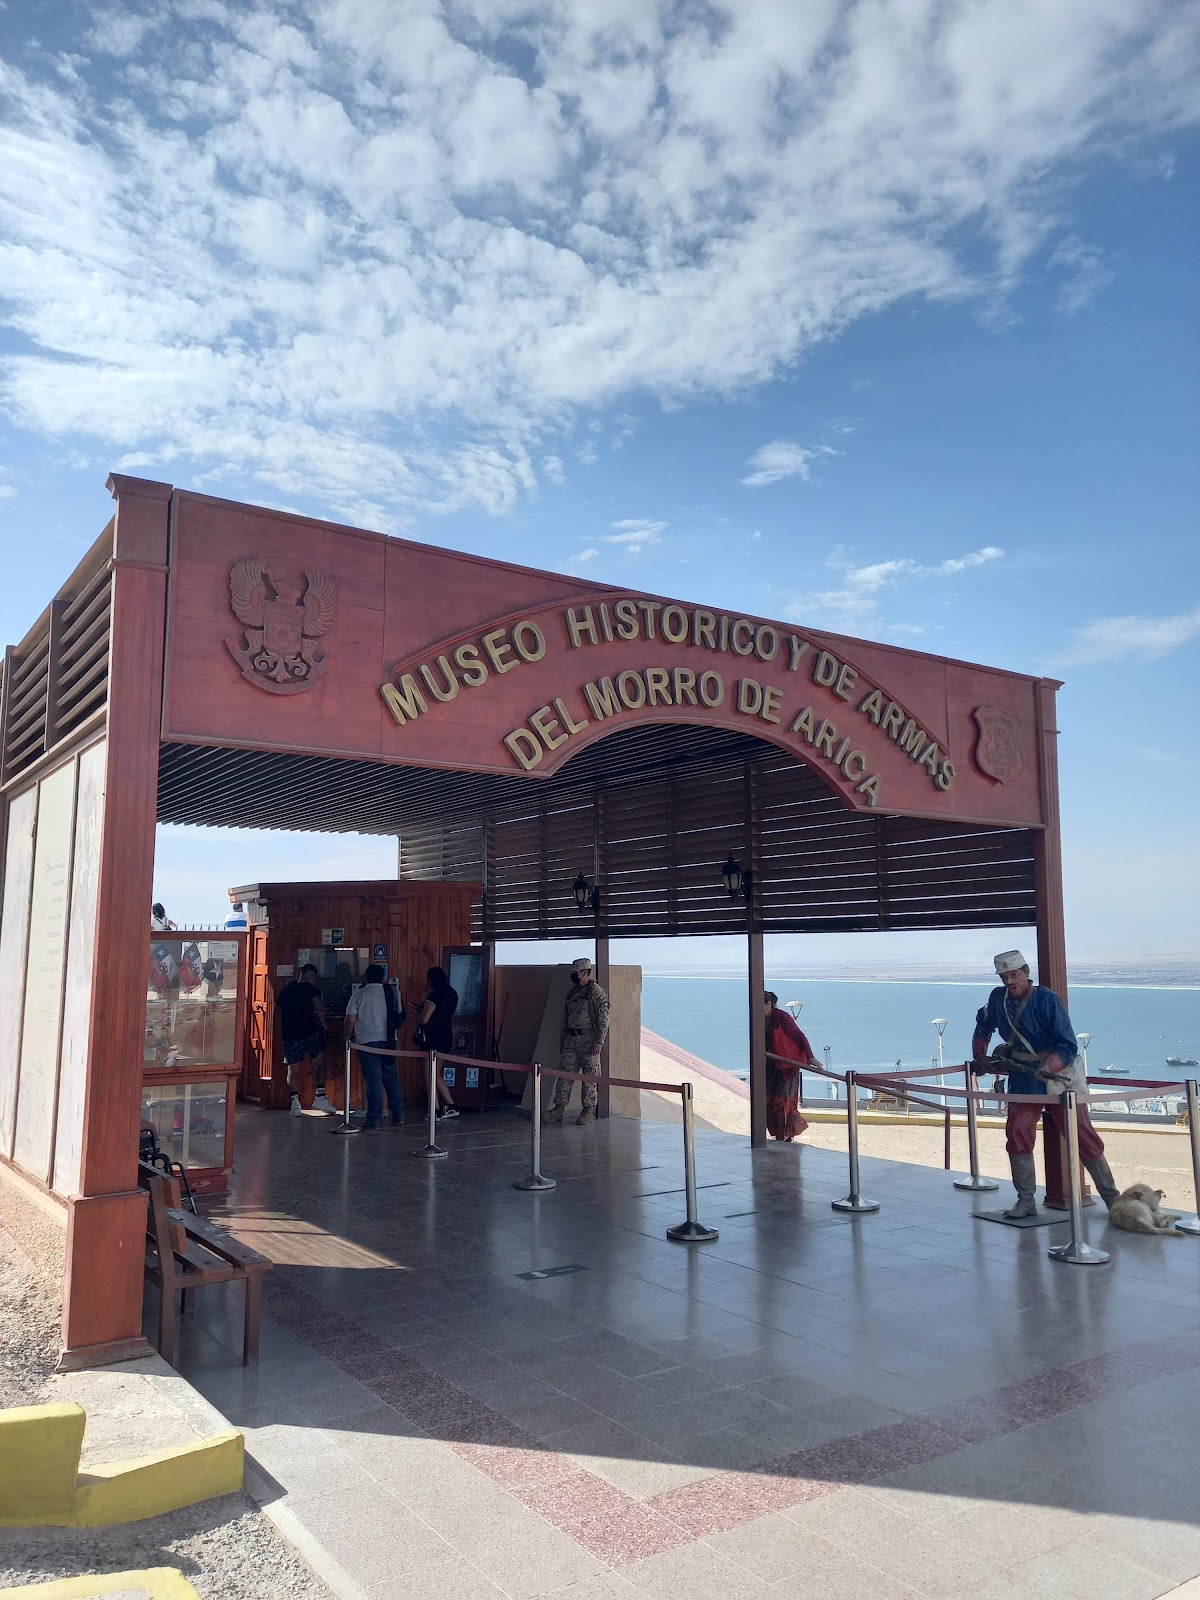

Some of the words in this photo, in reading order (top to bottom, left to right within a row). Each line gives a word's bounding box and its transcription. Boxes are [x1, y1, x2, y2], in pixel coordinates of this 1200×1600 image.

[379, 620, 547, 726] MUSEO
[565, 600, 779, 662] HISTORICO
[788, 634, 811, 672] Y
[813, 650, 859, 702] DE
[859, 689, 956, 792] ARMAS
[503, 697, 589, 771] DEL
[583, 667, 724, 721] MORRO
[737, 677, 784, 724] DE
[791, 706, 883, 807] ARICA
